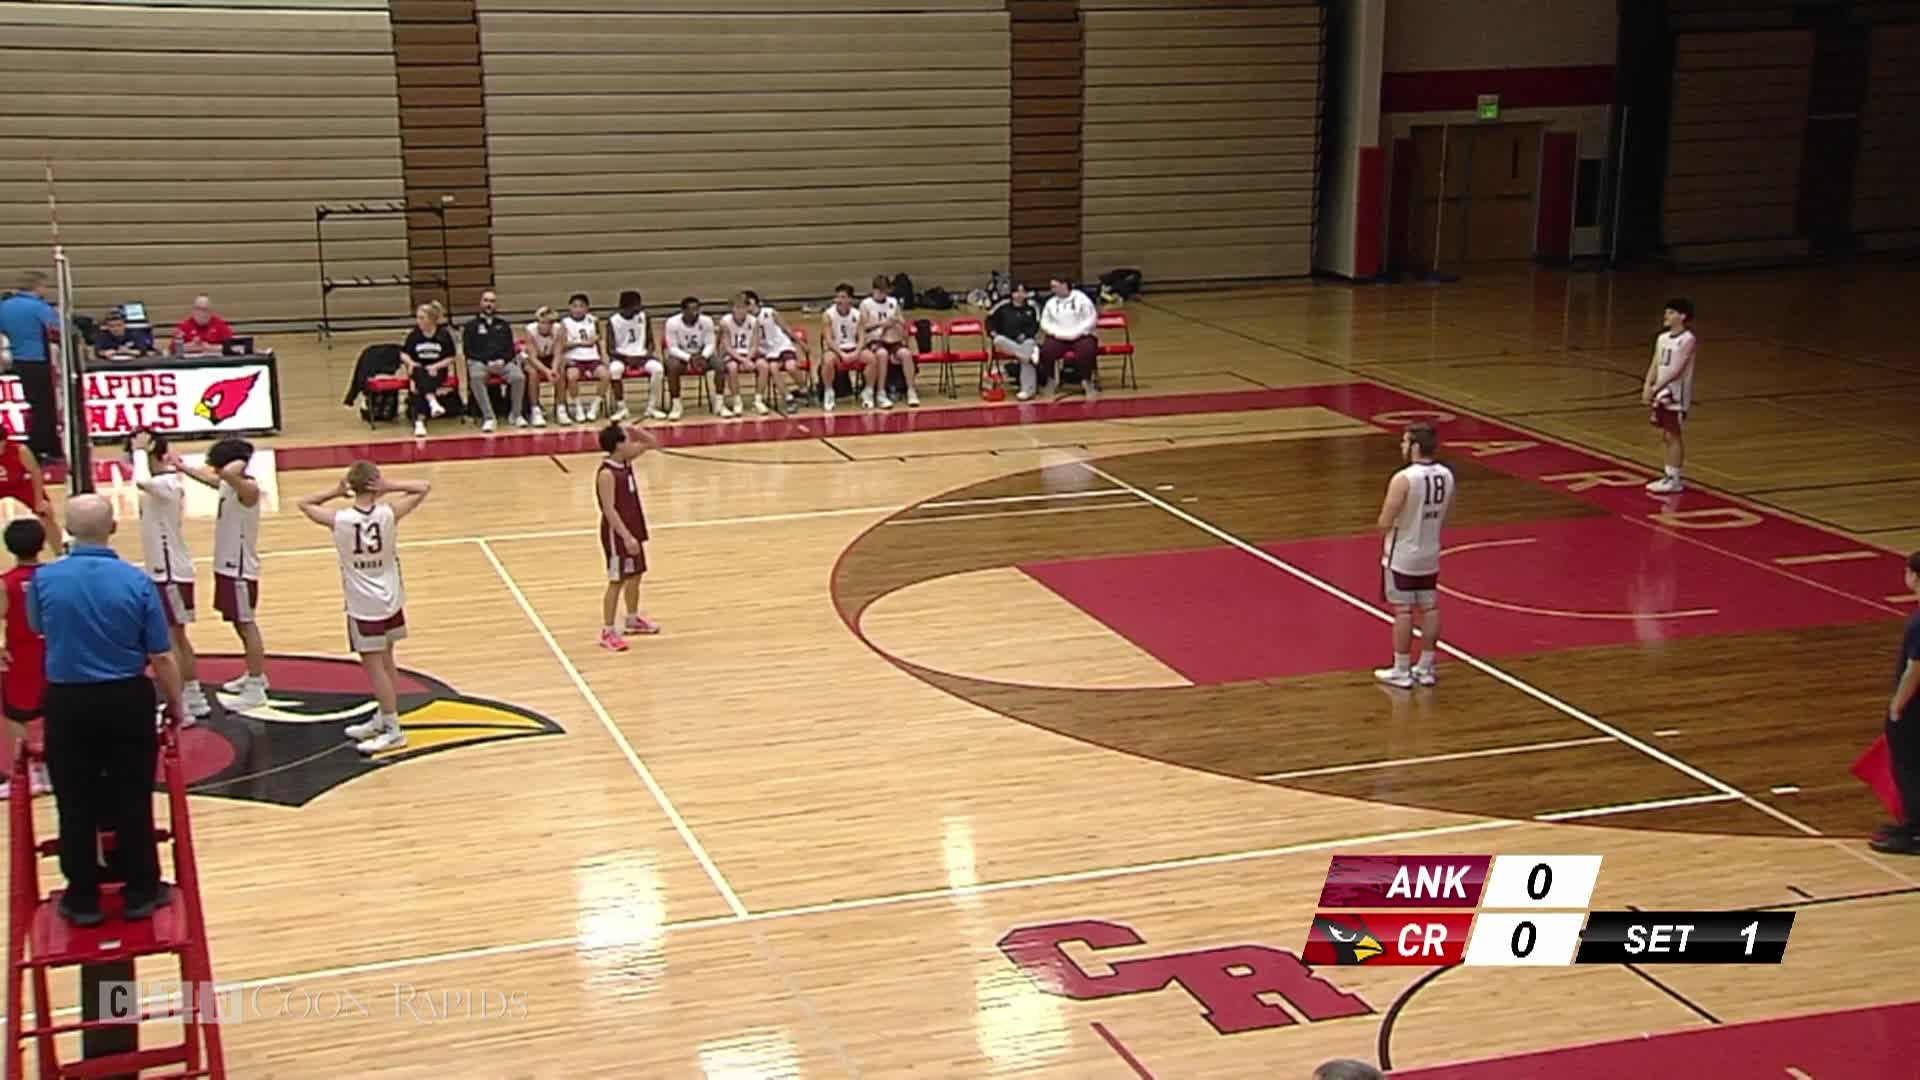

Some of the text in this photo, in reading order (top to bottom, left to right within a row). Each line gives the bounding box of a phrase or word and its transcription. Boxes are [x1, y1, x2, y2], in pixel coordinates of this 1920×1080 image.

[87, 373, 178, 400] APIDS
[1424, 474, 1446, 505] 18
[1371, 411, 1920, 604] CARDI
[352, 521, 383, 555] 13
[998, 919, 1378, 1036] CR
